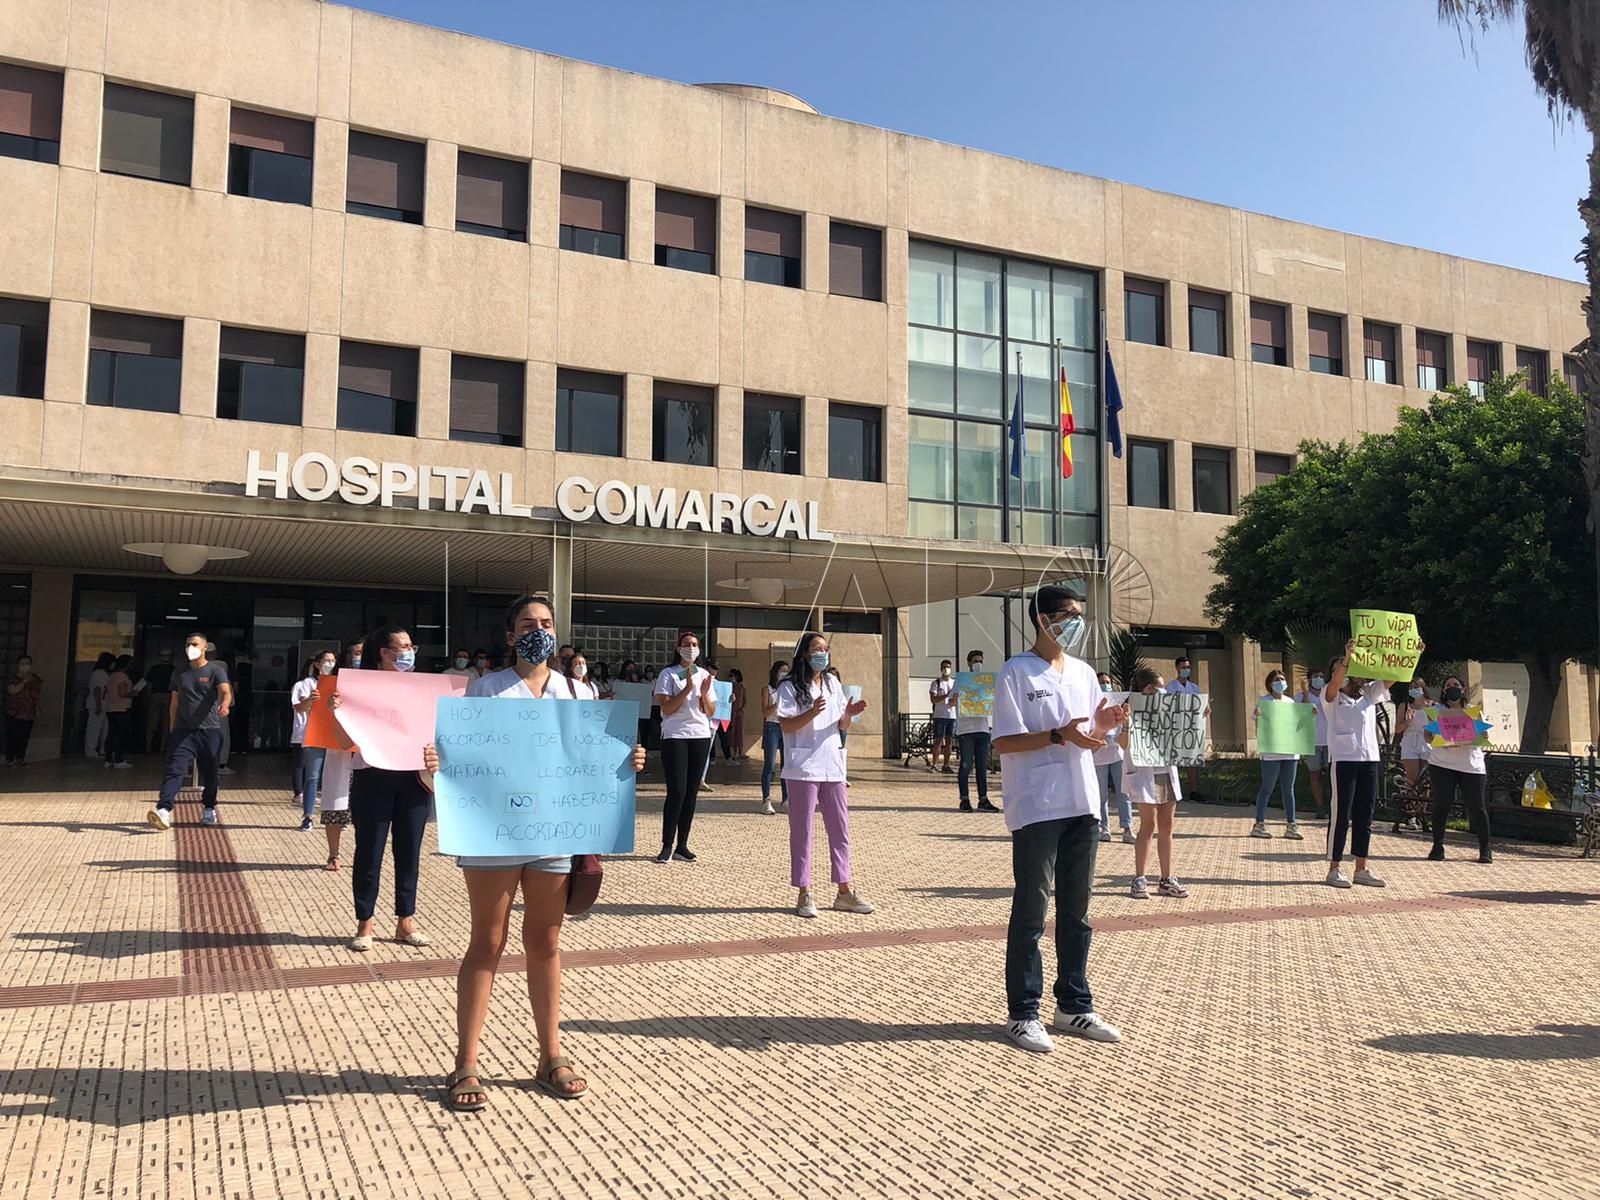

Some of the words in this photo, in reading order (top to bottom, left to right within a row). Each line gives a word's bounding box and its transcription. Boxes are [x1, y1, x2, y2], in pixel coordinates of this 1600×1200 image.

[244, 449, 532, 518] HOSPITAL
[555, 476, 834, 541] COMARCAL
[1354, 614, 1376, 630] TU
[1406, 637, 1421, 651] EN
[1380, 653, 1417, 669] MANOS
[450, 707, 484, 721] HOY
[517, 709, 540, 721] NO
[531, 732, 560, 747] DE
[443, 795, 482, 809] POR
[510, 795, 533, 808] NO
[551, 791, 619, 808] HABEROS
